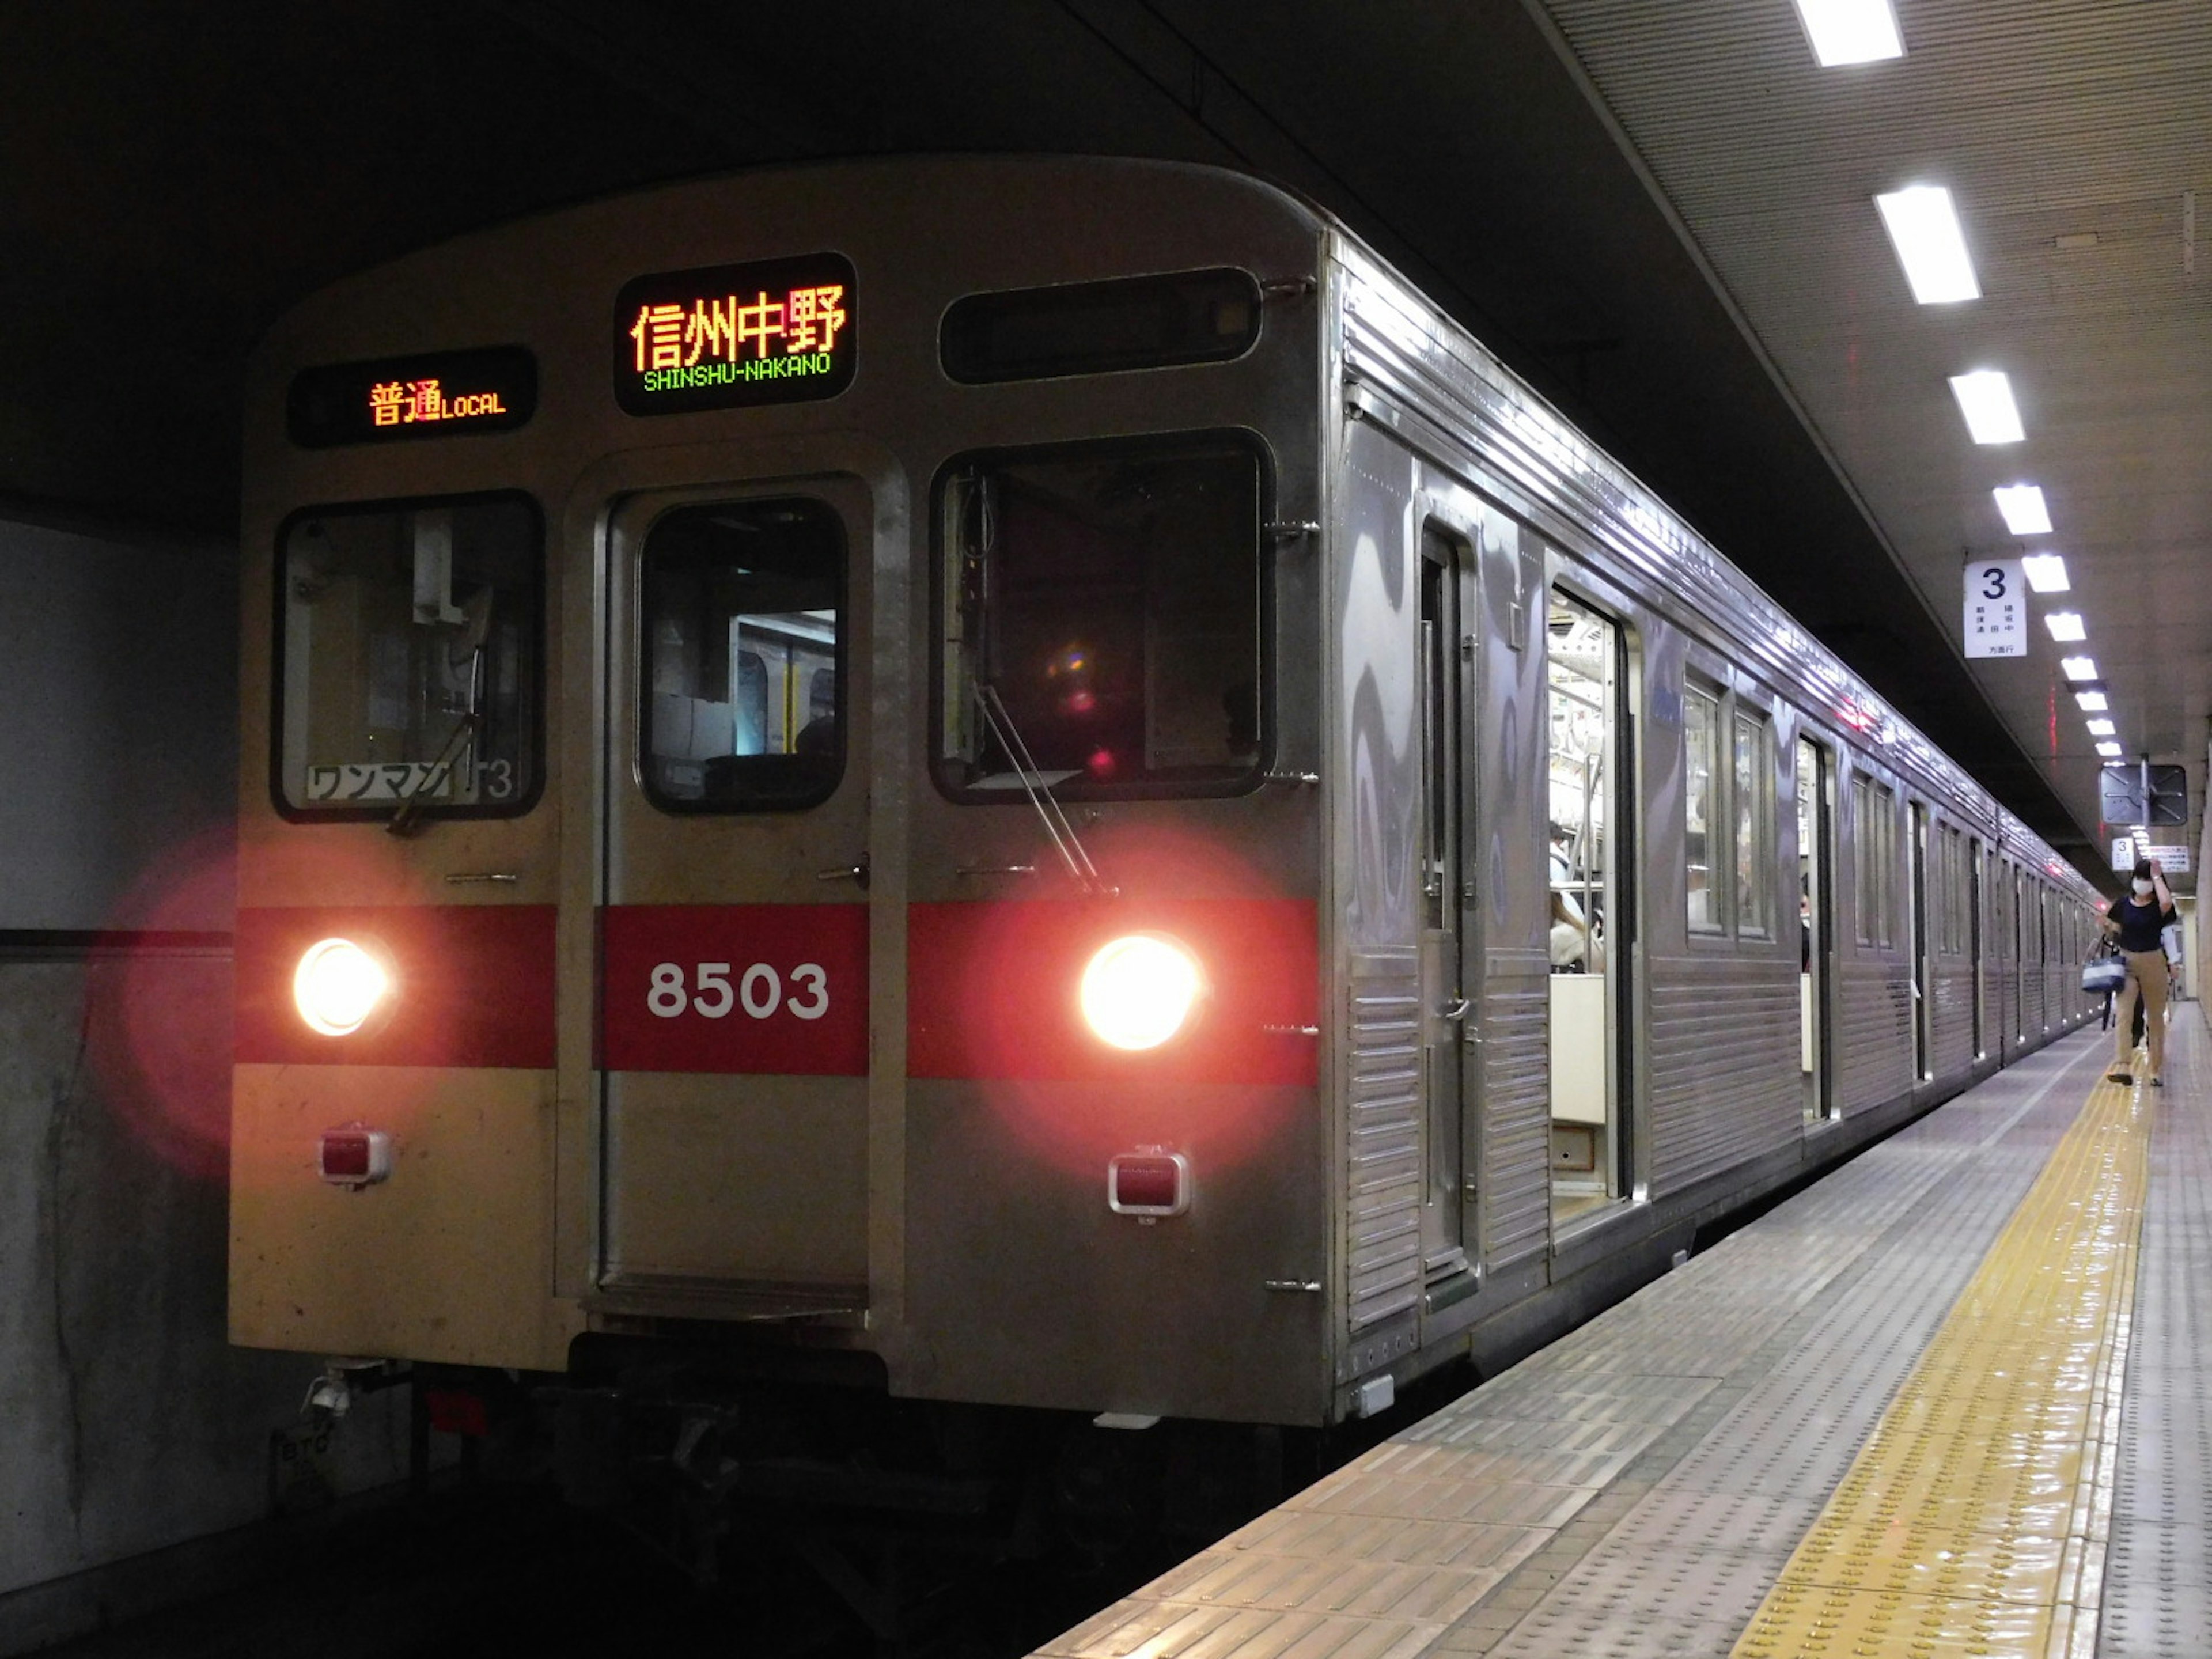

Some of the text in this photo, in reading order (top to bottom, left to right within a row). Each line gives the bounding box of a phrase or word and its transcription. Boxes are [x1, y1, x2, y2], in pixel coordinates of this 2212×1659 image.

[630, 285, 846, 371] 信州中野
[643, 353, 831, 391] SHINSHU-NAKANO
[369, 380, 441, 426] 普通
[442, 393, 506, 419] LOCAL
[1983, 568, 2006, 599] 3
[315, 764, 448, 800] ワンマン
[2118, 841, 2127, 851] 3
[647, 962, 830, 1020] 8503
